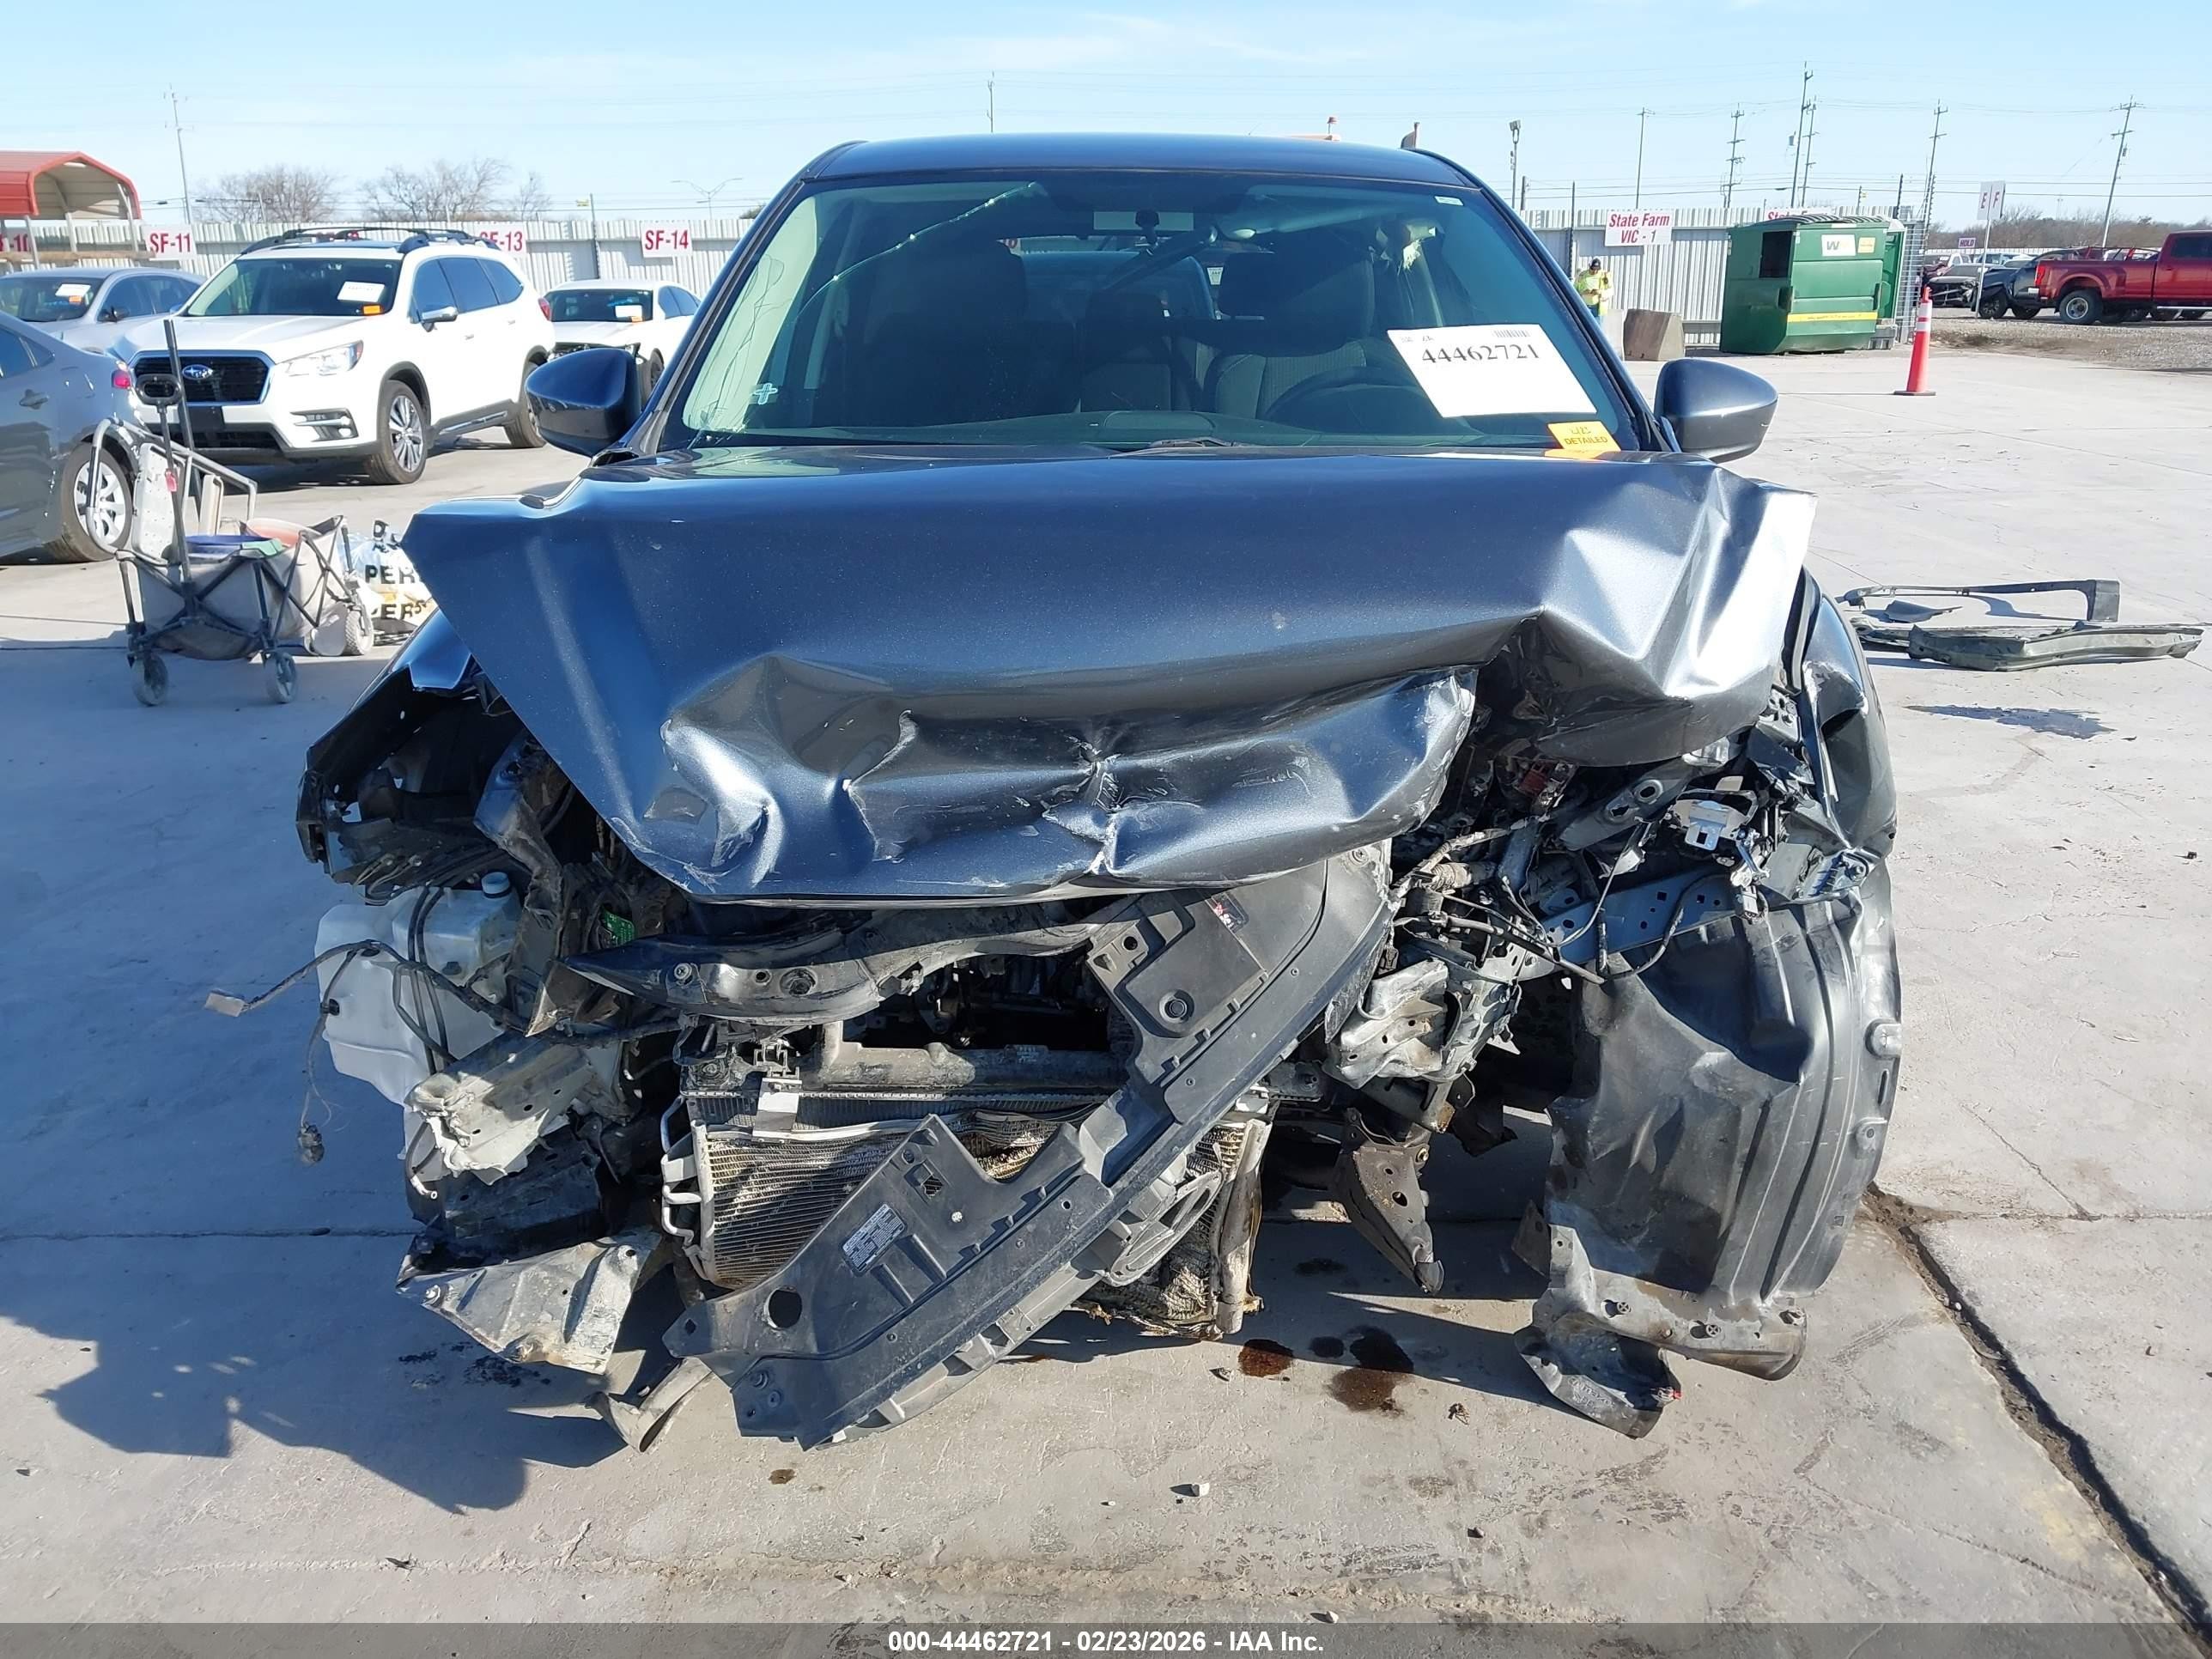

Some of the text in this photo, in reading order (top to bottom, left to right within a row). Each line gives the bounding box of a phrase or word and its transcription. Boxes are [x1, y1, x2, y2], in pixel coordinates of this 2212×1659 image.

[1608, 212, 1670, 228] State Farm
[149, 232, 191, 254] SF-11
[644, 229, 689, 251] SF-14
[1621, 228, 1640, 244] VIC
[1421, 343, 1540, 364] 44462721
[1564, 435, 1608, 446] DETAILED
